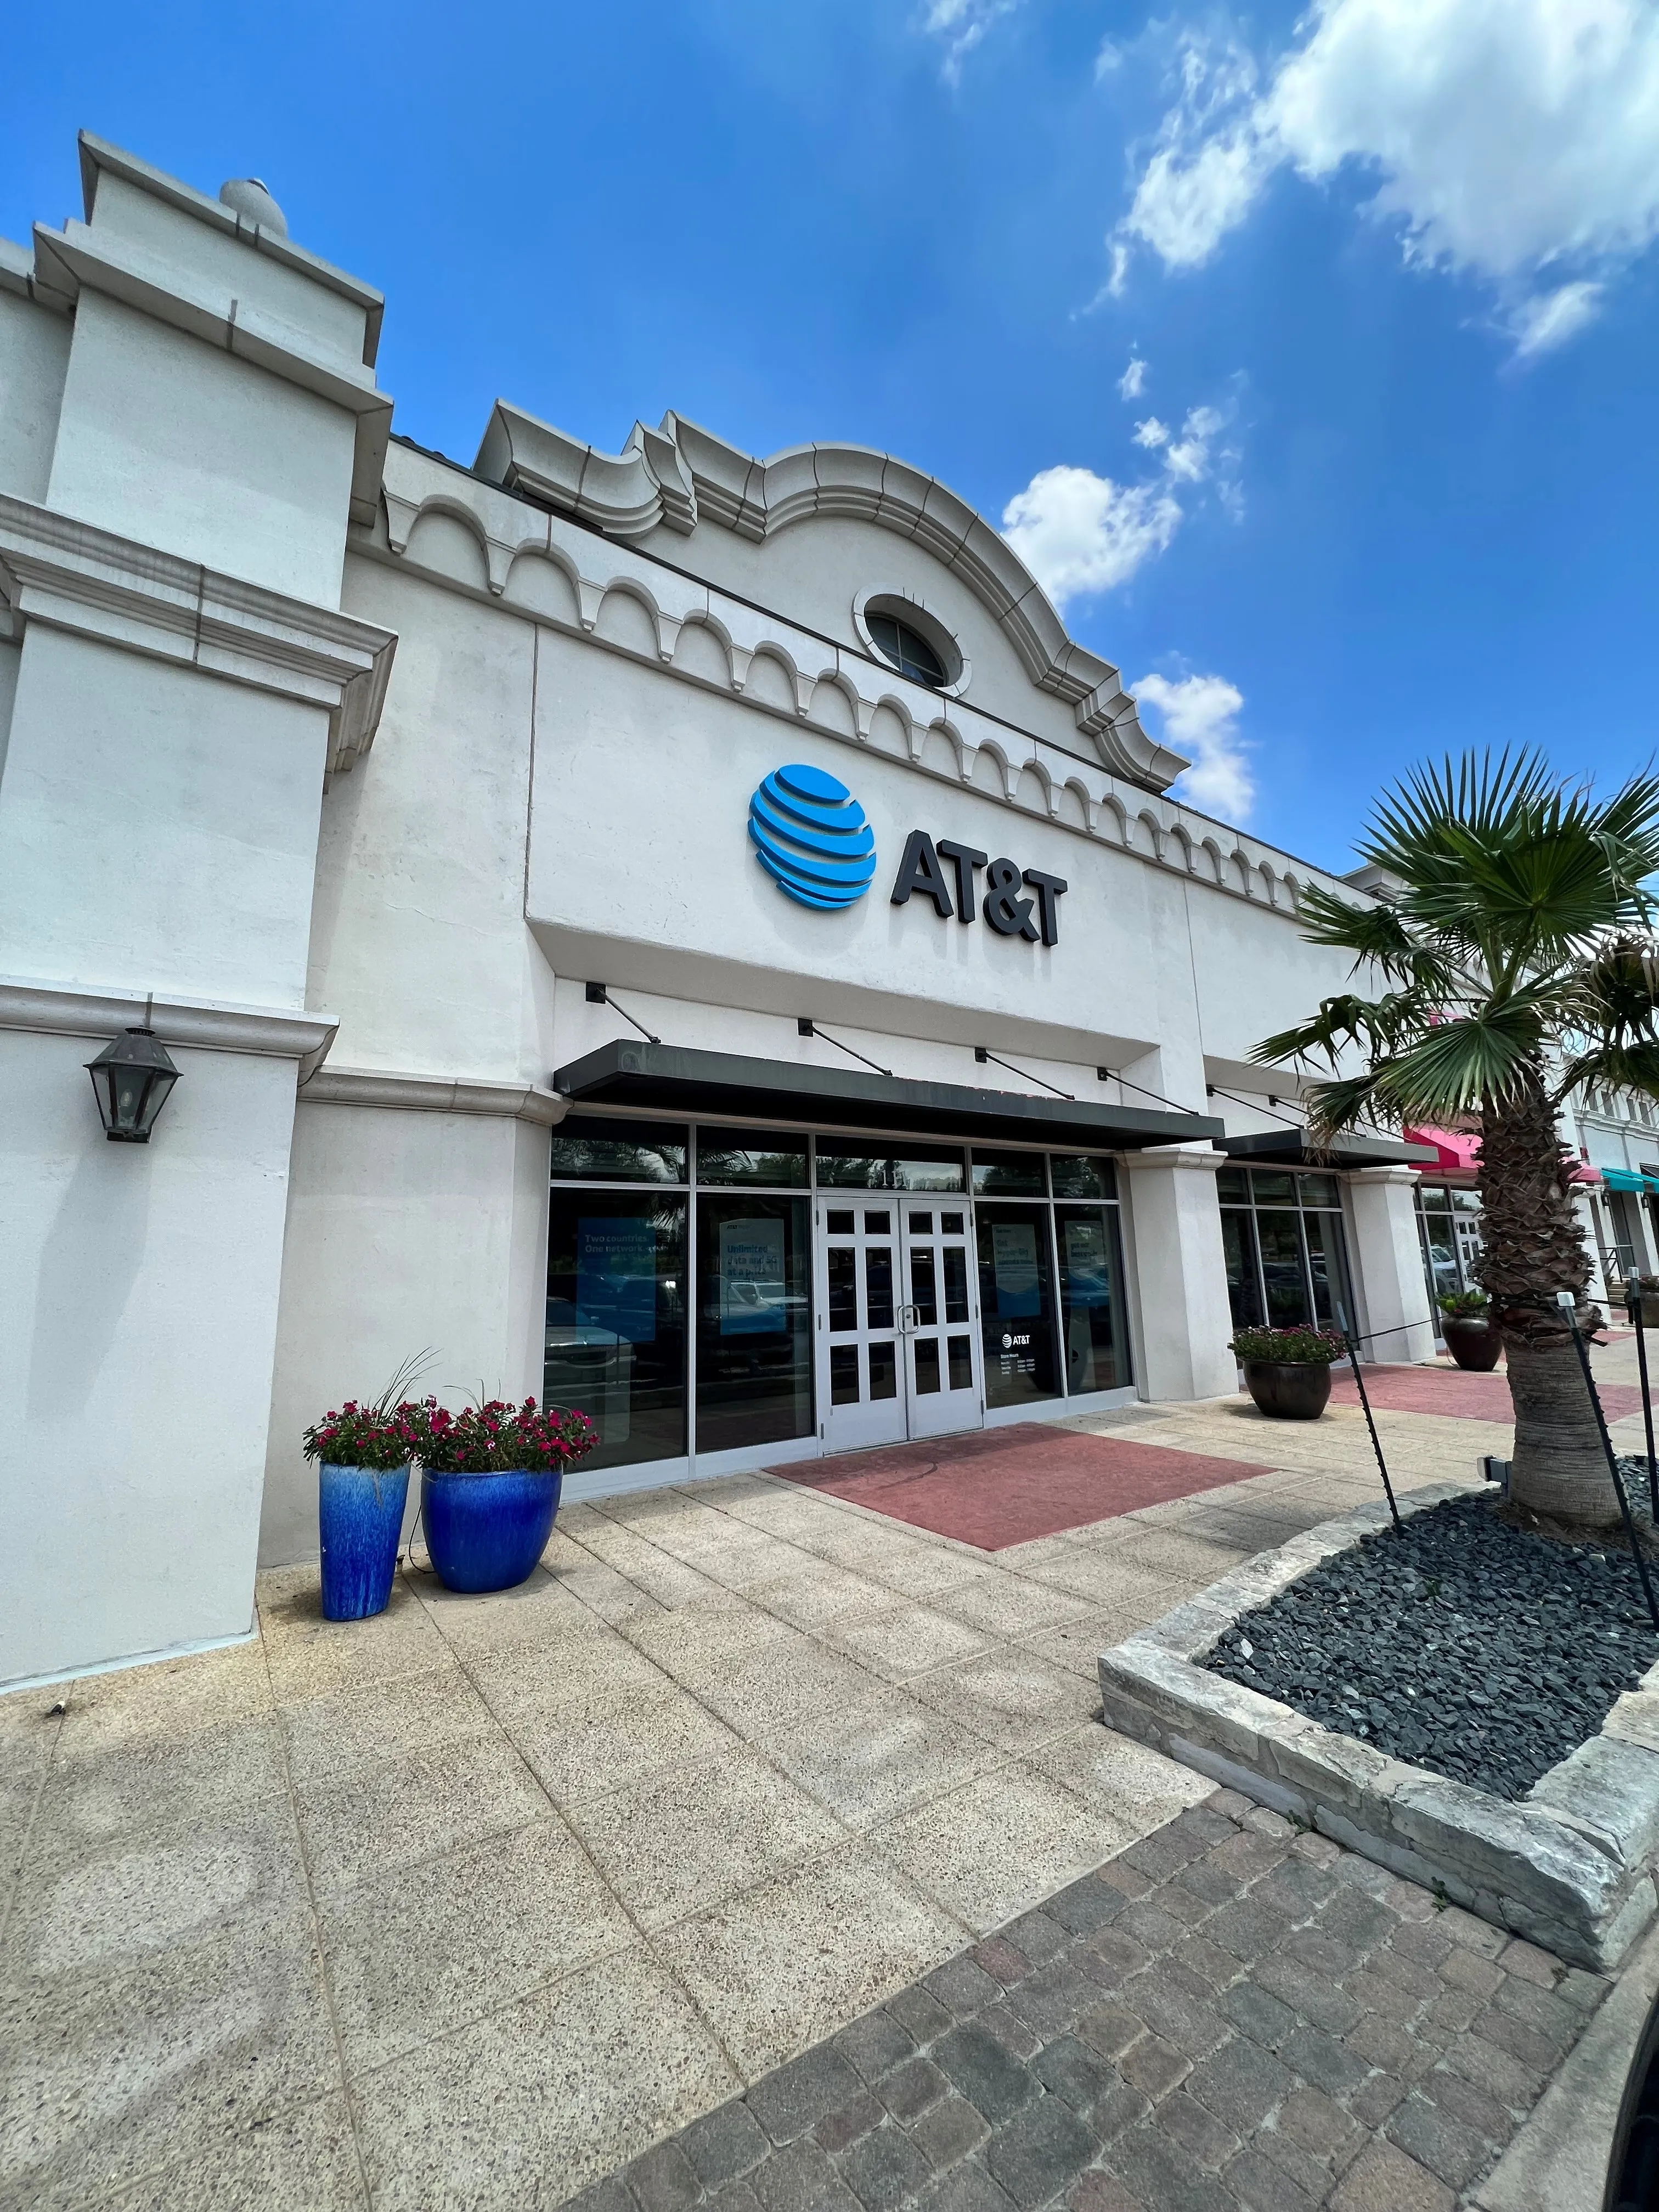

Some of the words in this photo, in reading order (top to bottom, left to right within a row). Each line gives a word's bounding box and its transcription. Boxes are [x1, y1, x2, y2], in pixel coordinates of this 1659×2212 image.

[890, 829, 1068, 946] AT&T
[585, 1234, 605, 1243] Two
[585, 1244, 603, 1253] One
[727, 1244, 768, 1253] Unlimited
[766, 1256, 777, 1264] 5G
[1013, 1335, 1030, 1345] AT&T
